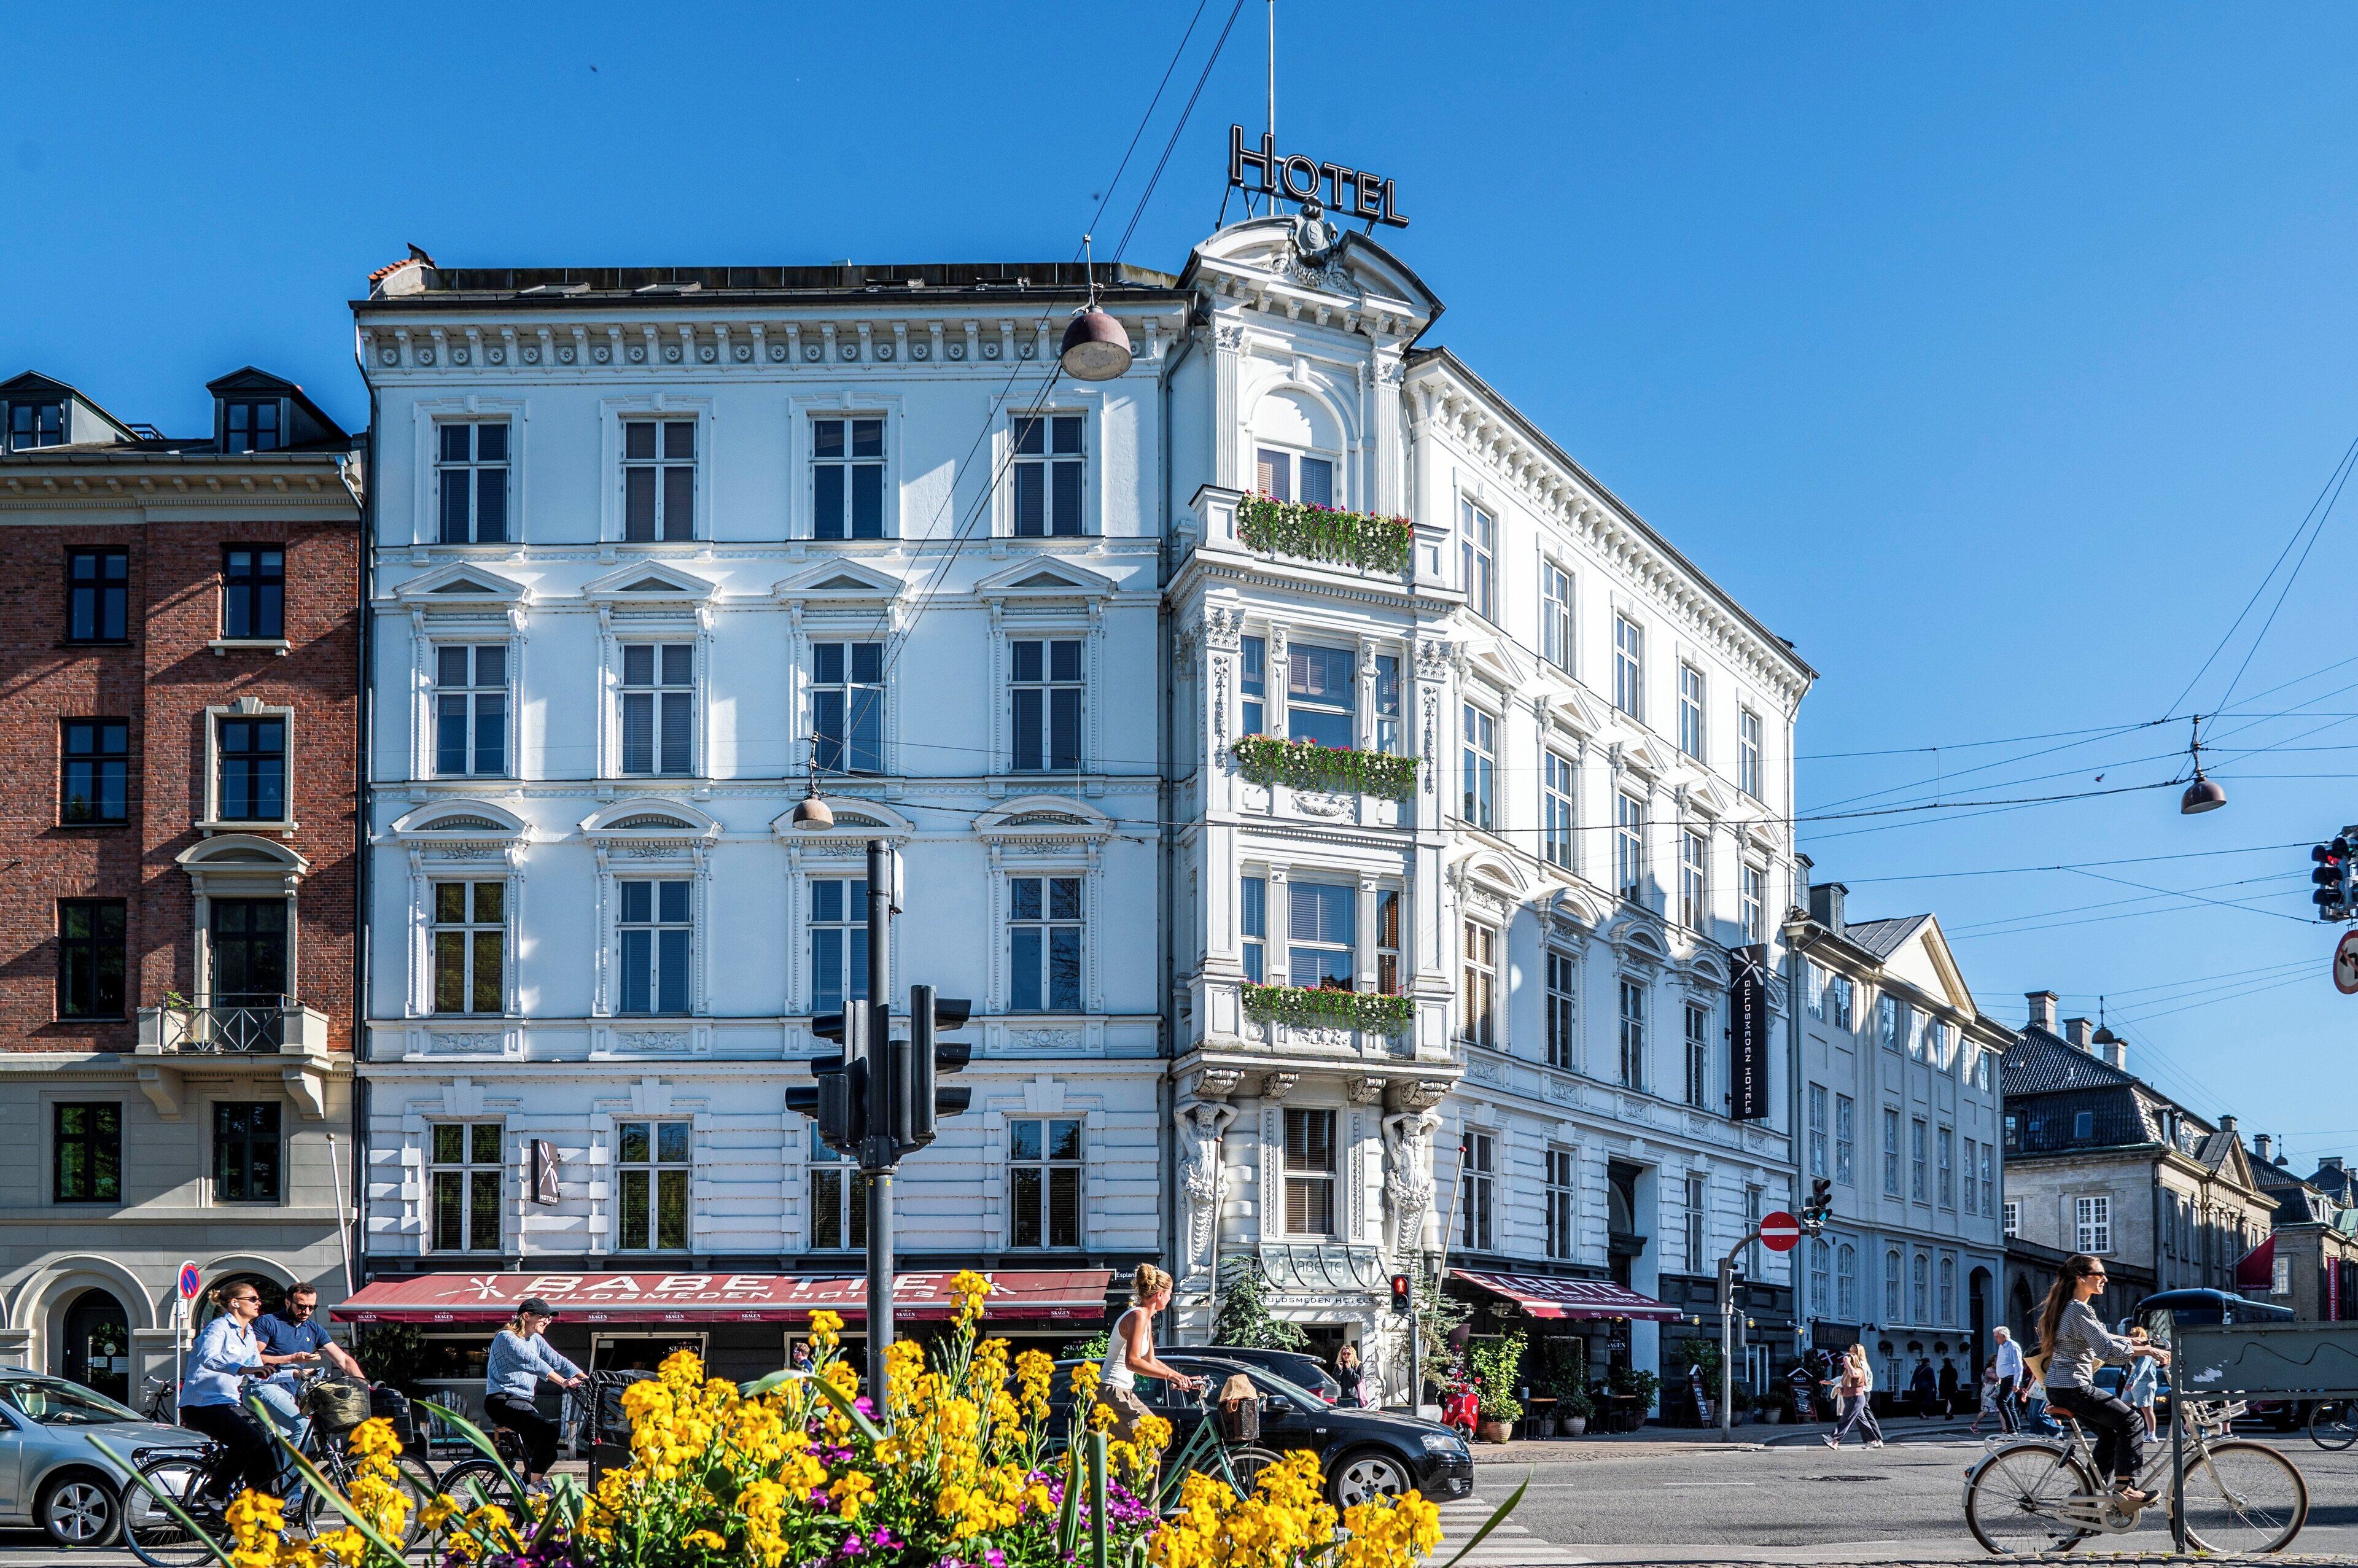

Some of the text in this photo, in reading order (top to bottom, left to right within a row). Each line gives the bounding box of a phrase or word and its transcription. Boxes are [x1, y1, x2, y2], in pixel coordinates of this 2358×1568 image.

[1229, 123, 1409, 229] HOTEL
[540, 1193, 558, 1203] HOTELS
[1288, 1261, 1342, 1273] ABETE
[523, 1275, 943, 1292] BABETTE
[1461, 1272, 1637, 1297] BABETTE
[512, 1290, 935, 1300] GULDSMEDEN HOTLS
